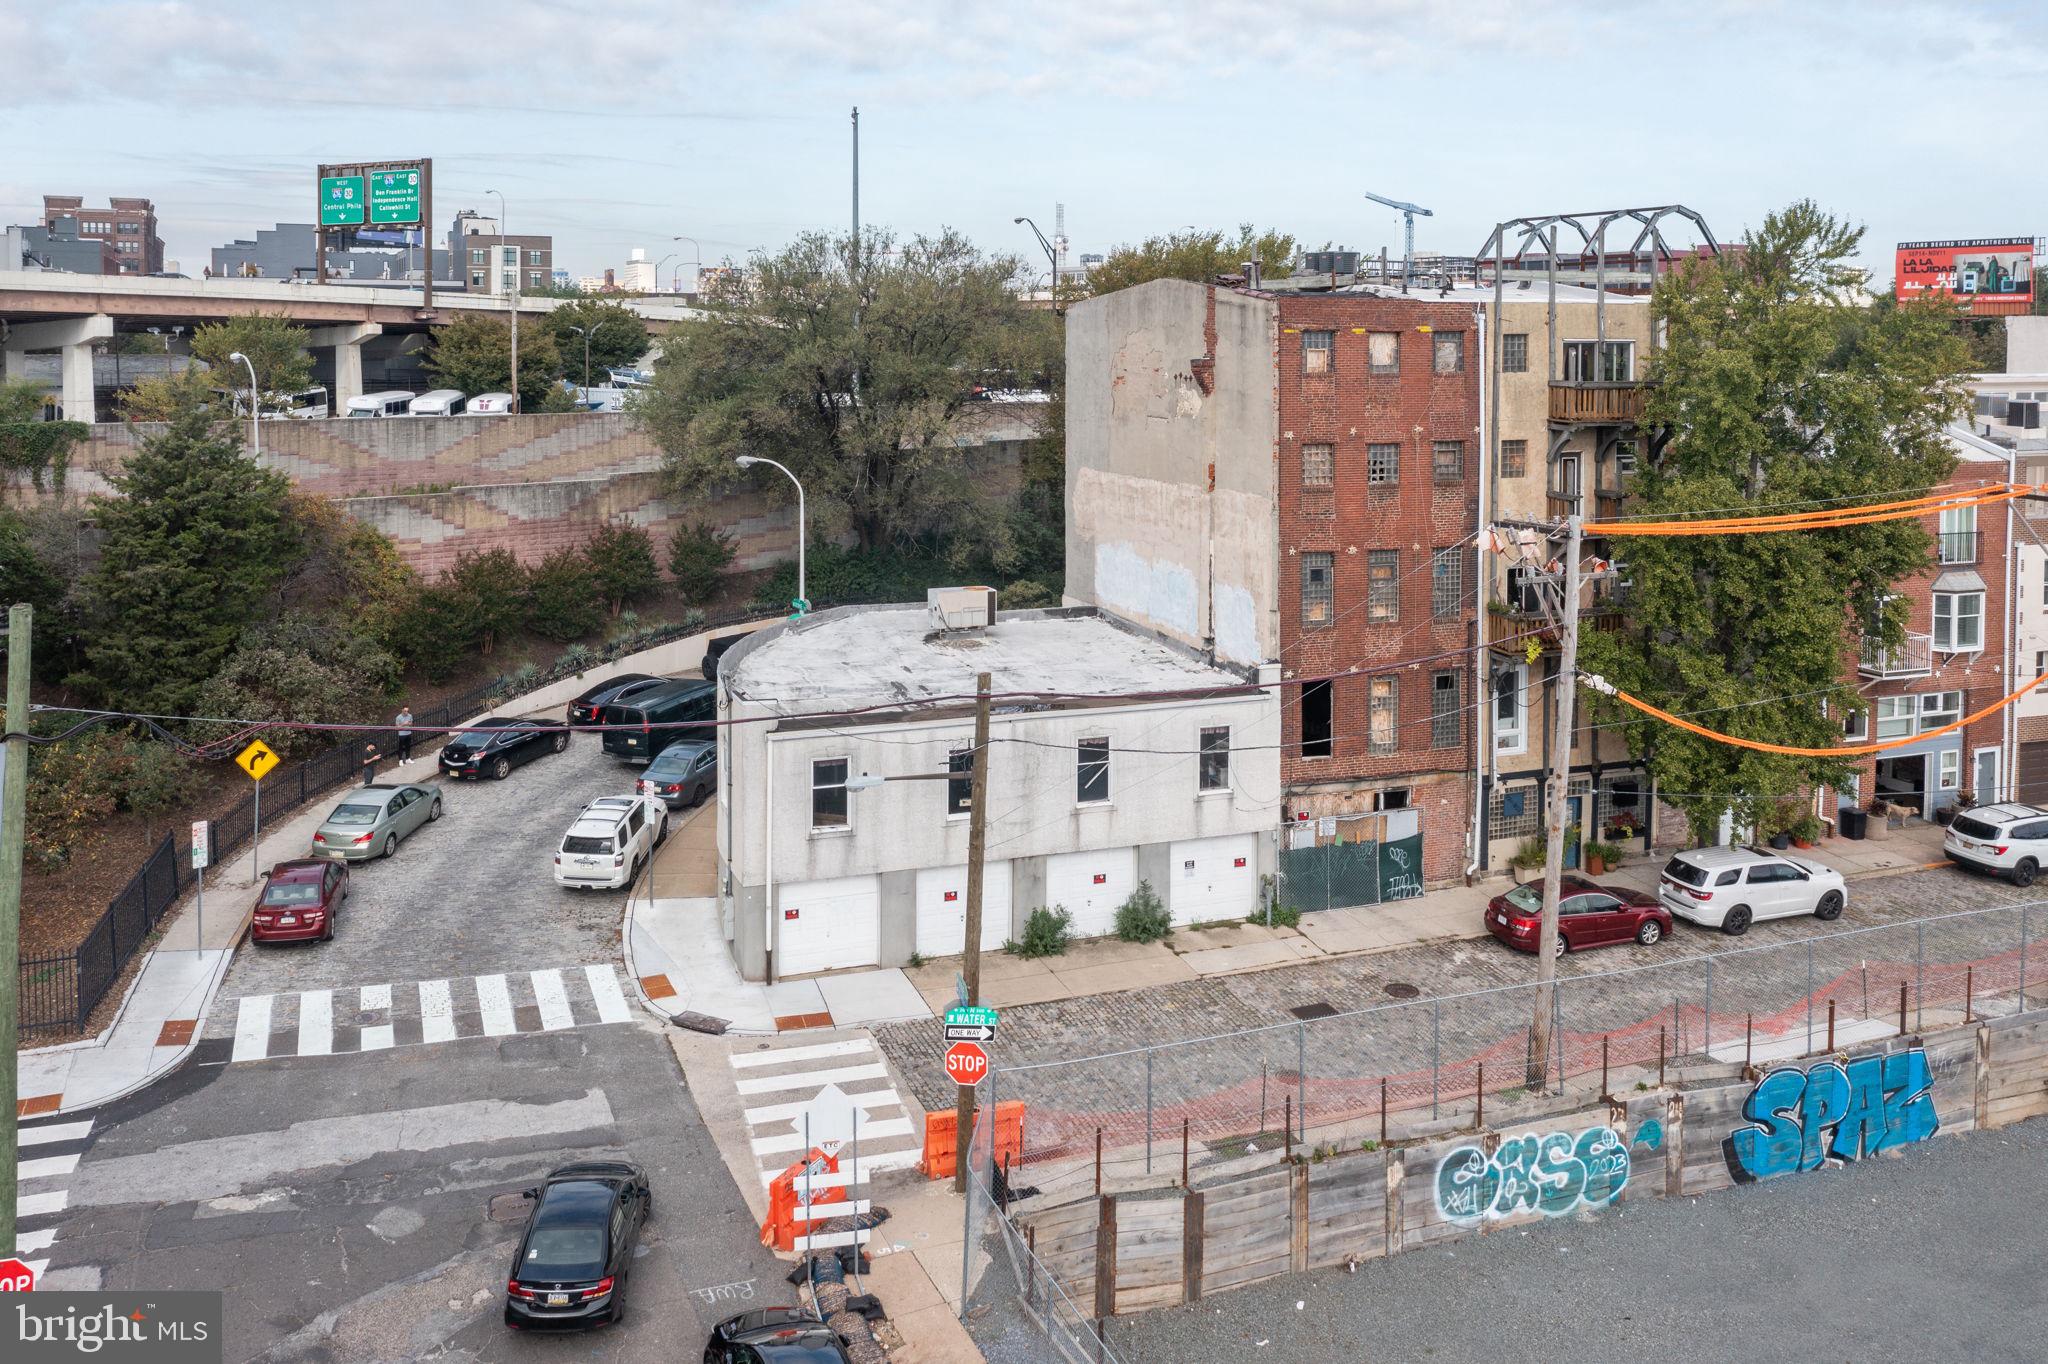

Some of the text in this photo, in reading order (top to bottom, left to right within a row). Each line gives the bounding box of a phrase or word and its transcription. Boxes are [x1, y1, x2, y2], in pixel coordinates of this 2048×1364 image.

[324, 202, 362, 211] Central Phila
[957, 1014, 986, 1024] WATER
[950, 1028, 980, 1036] ONE WAY
[948, 1054, 985, 1072] STOP
[1589, 1154, 1626, 1180] 2023
